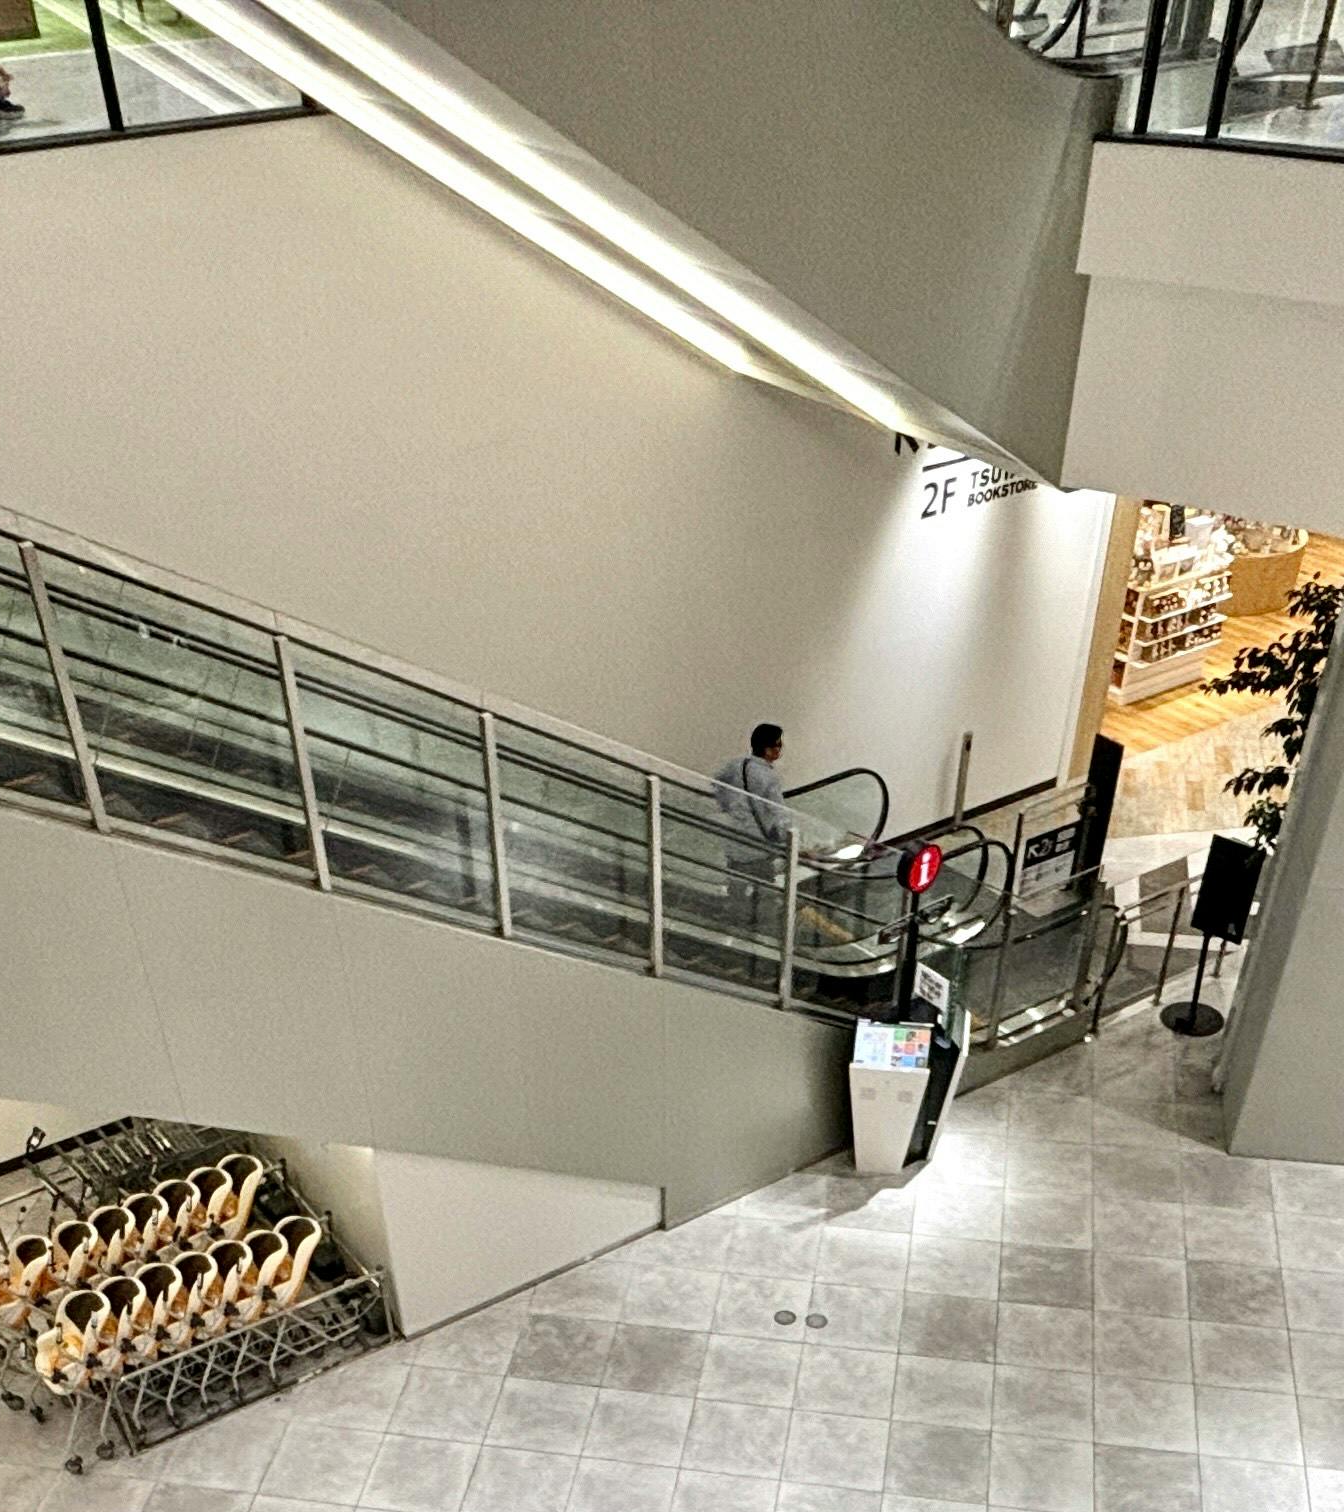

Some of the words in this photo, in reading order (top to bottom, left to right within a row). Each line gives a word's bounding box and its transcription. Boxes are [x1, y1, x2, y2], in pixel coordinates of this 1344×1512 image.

[920, 477, 958, 520] 2F
[970, 464, 1015, 490] TSU
[967, 478, 1038, 507] BOOKSTORE
